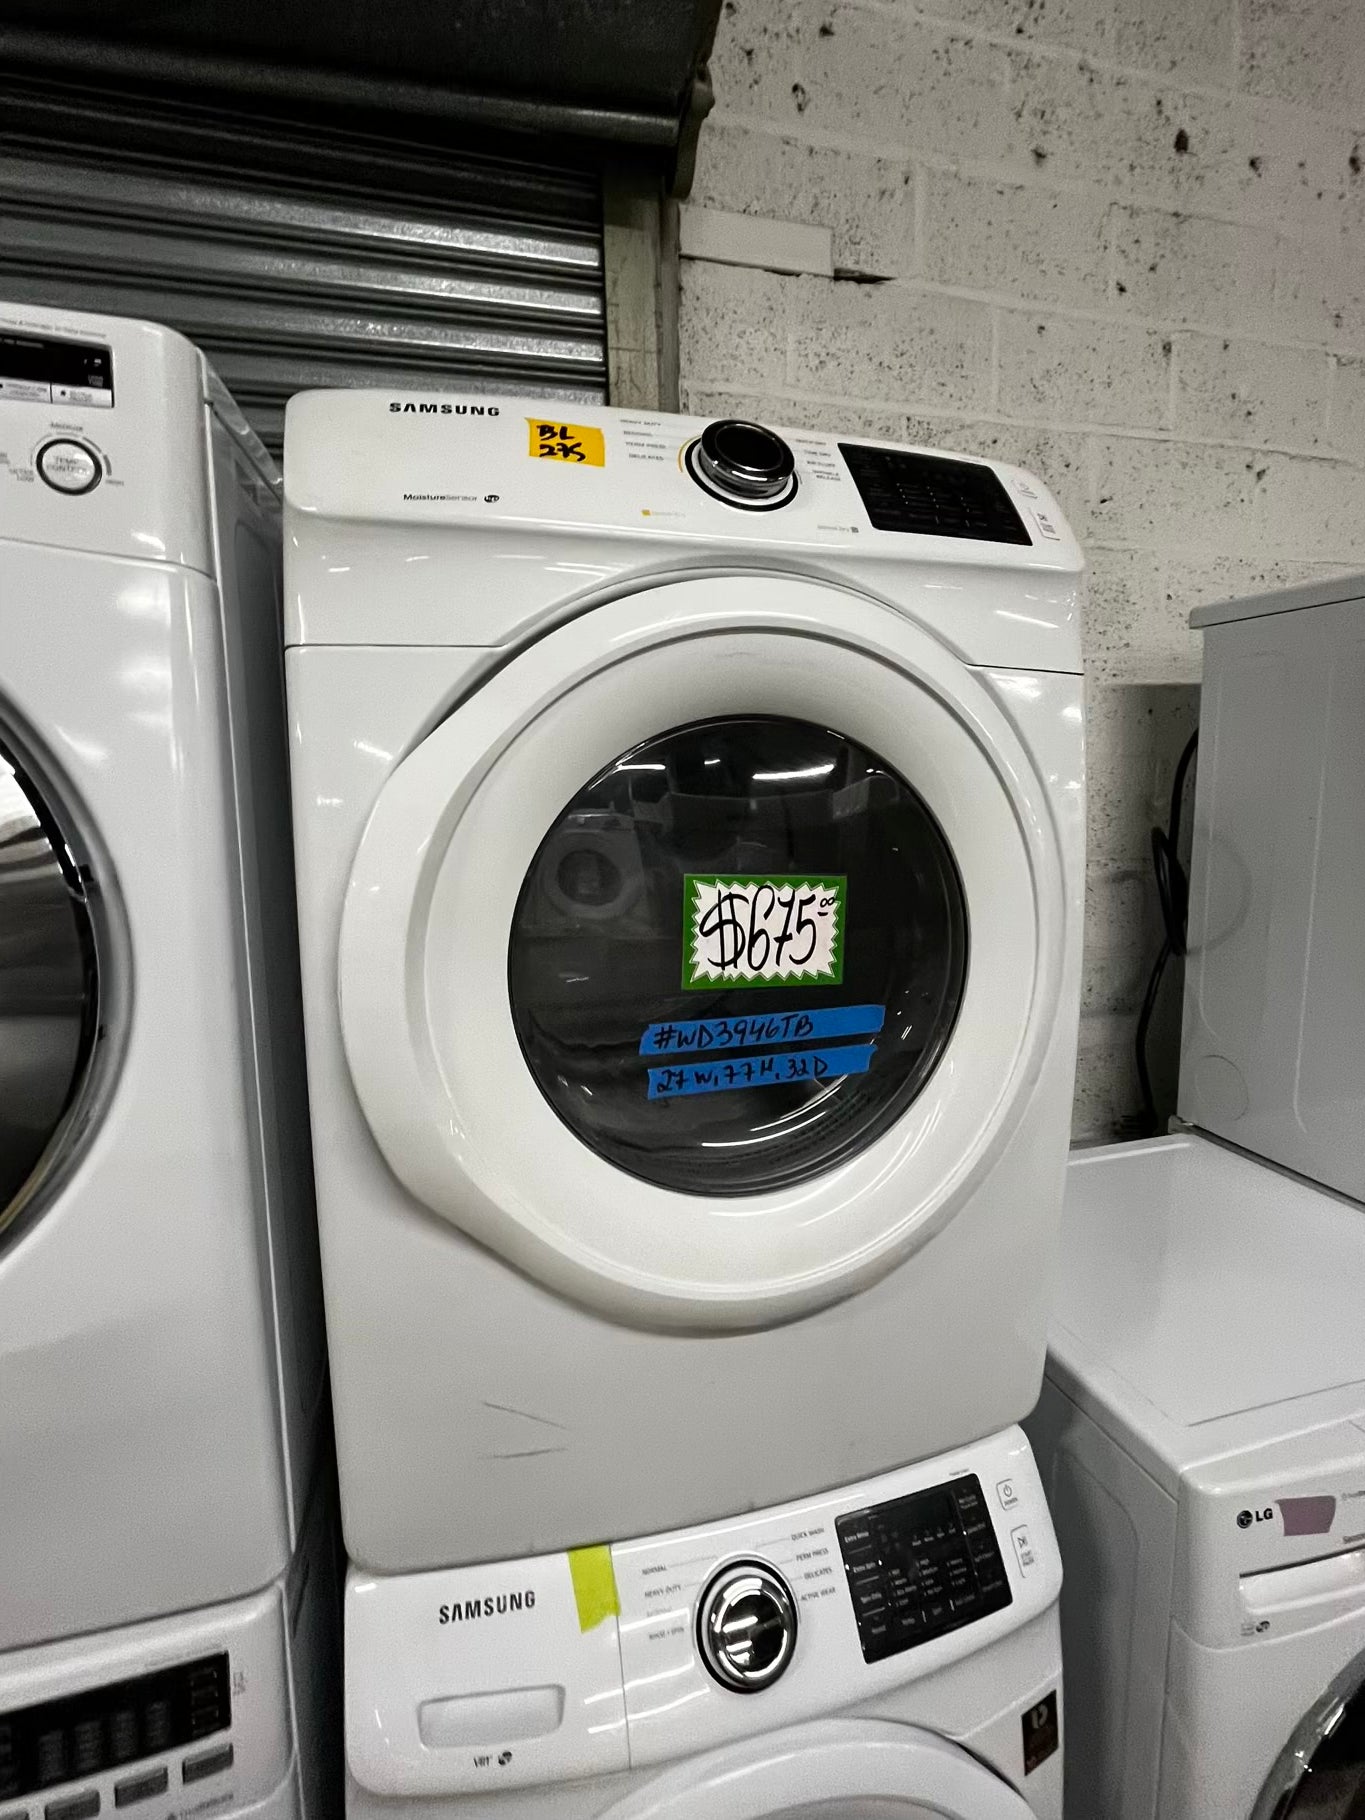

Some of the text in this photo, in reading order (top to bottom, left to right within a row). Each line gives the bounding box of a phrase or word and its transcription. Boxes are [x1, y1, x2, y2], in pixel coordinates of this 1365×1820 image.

[389, 402, 500, 417] SAMSUNG
[536, 424, 576, 441] BL
[539, 442, 586, 462] 275
[653, 1014, 814, 1050] #WD3946TB
[1255, 1508, 1274, 1522] LG
[438, 1590, 536, 1625] SAMSUNG
